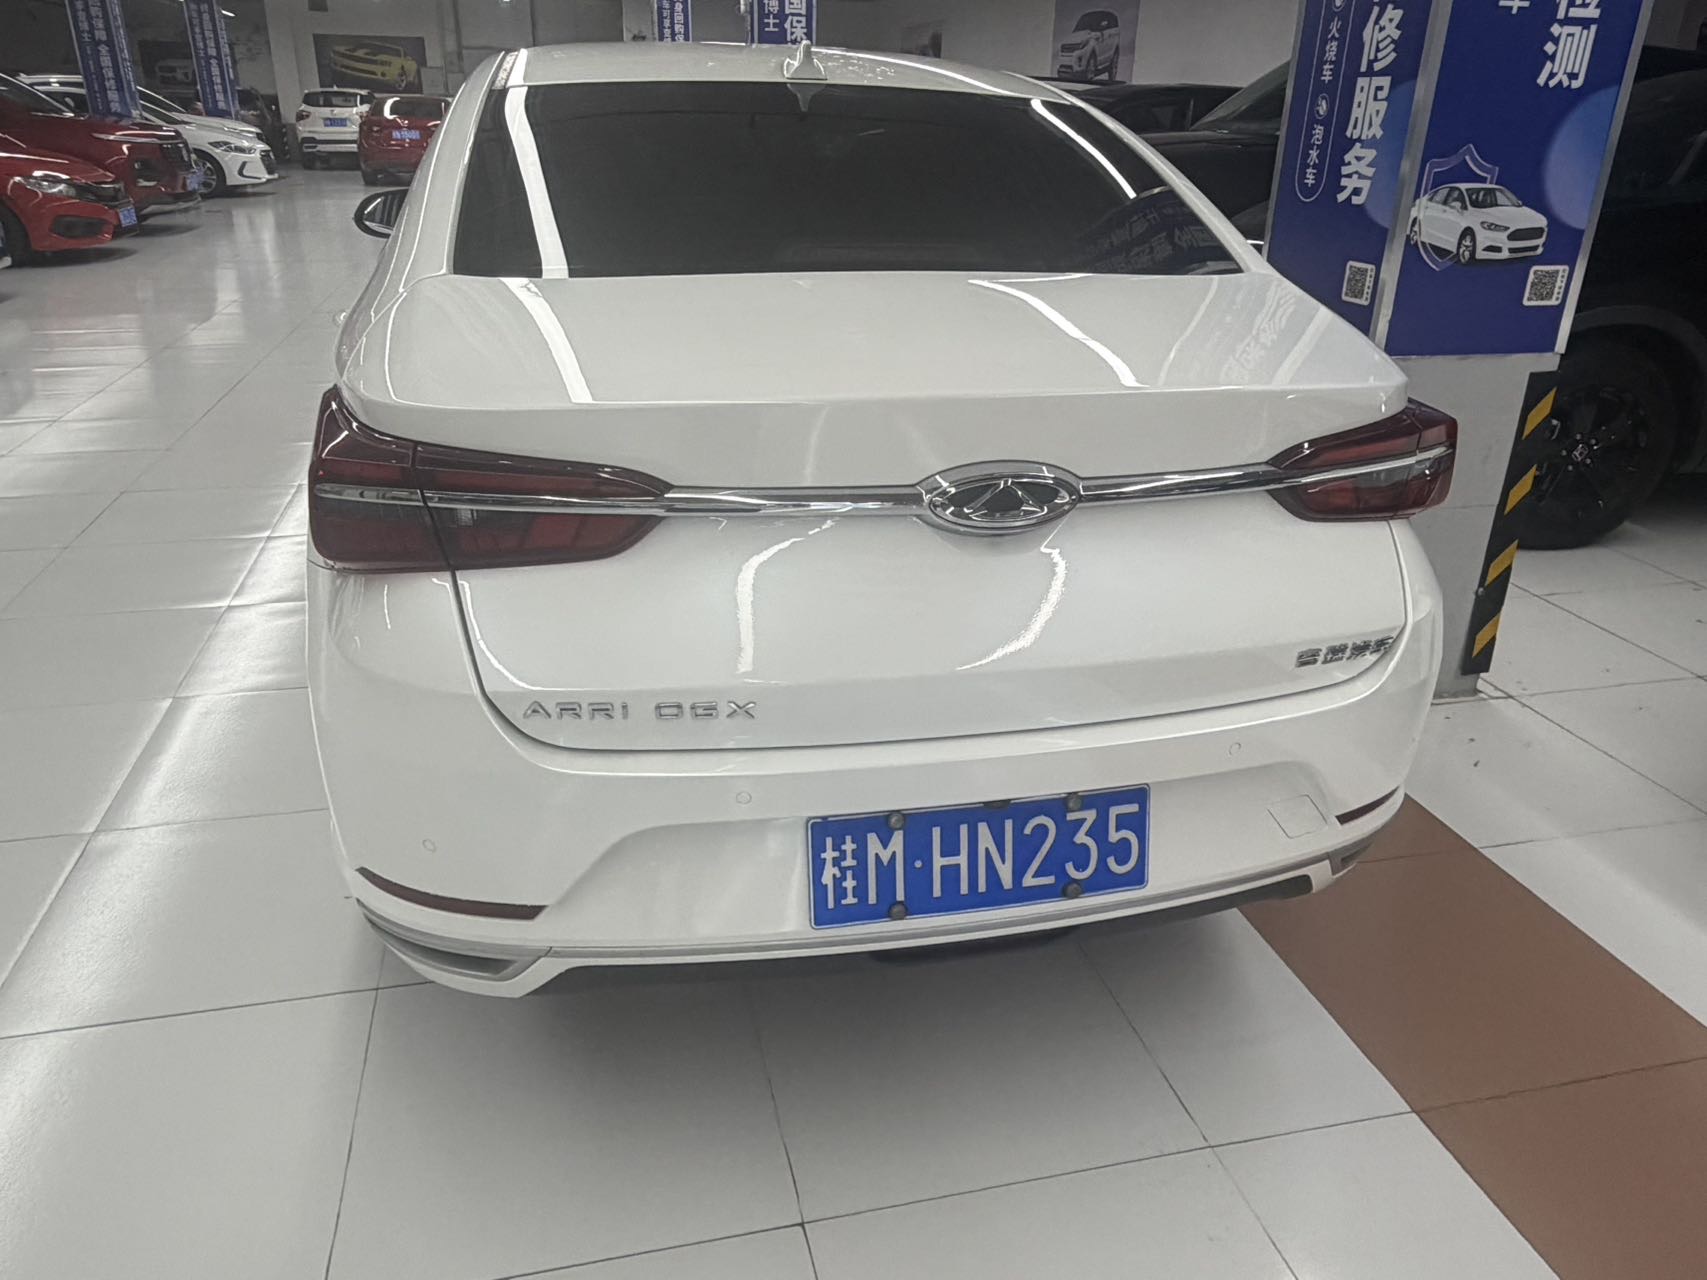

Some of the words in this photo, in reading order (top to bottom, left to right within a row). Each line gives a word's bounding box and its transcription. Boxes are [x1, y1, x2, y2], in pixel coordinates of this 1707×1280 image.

[1320, 16, 1342, 84] 火烧车
[1336, 3, 1404, 206] 修服务
[1303, 124, 1325, 188] 泡水车
[820, 803, 1141, 910] 桂M·HN235
